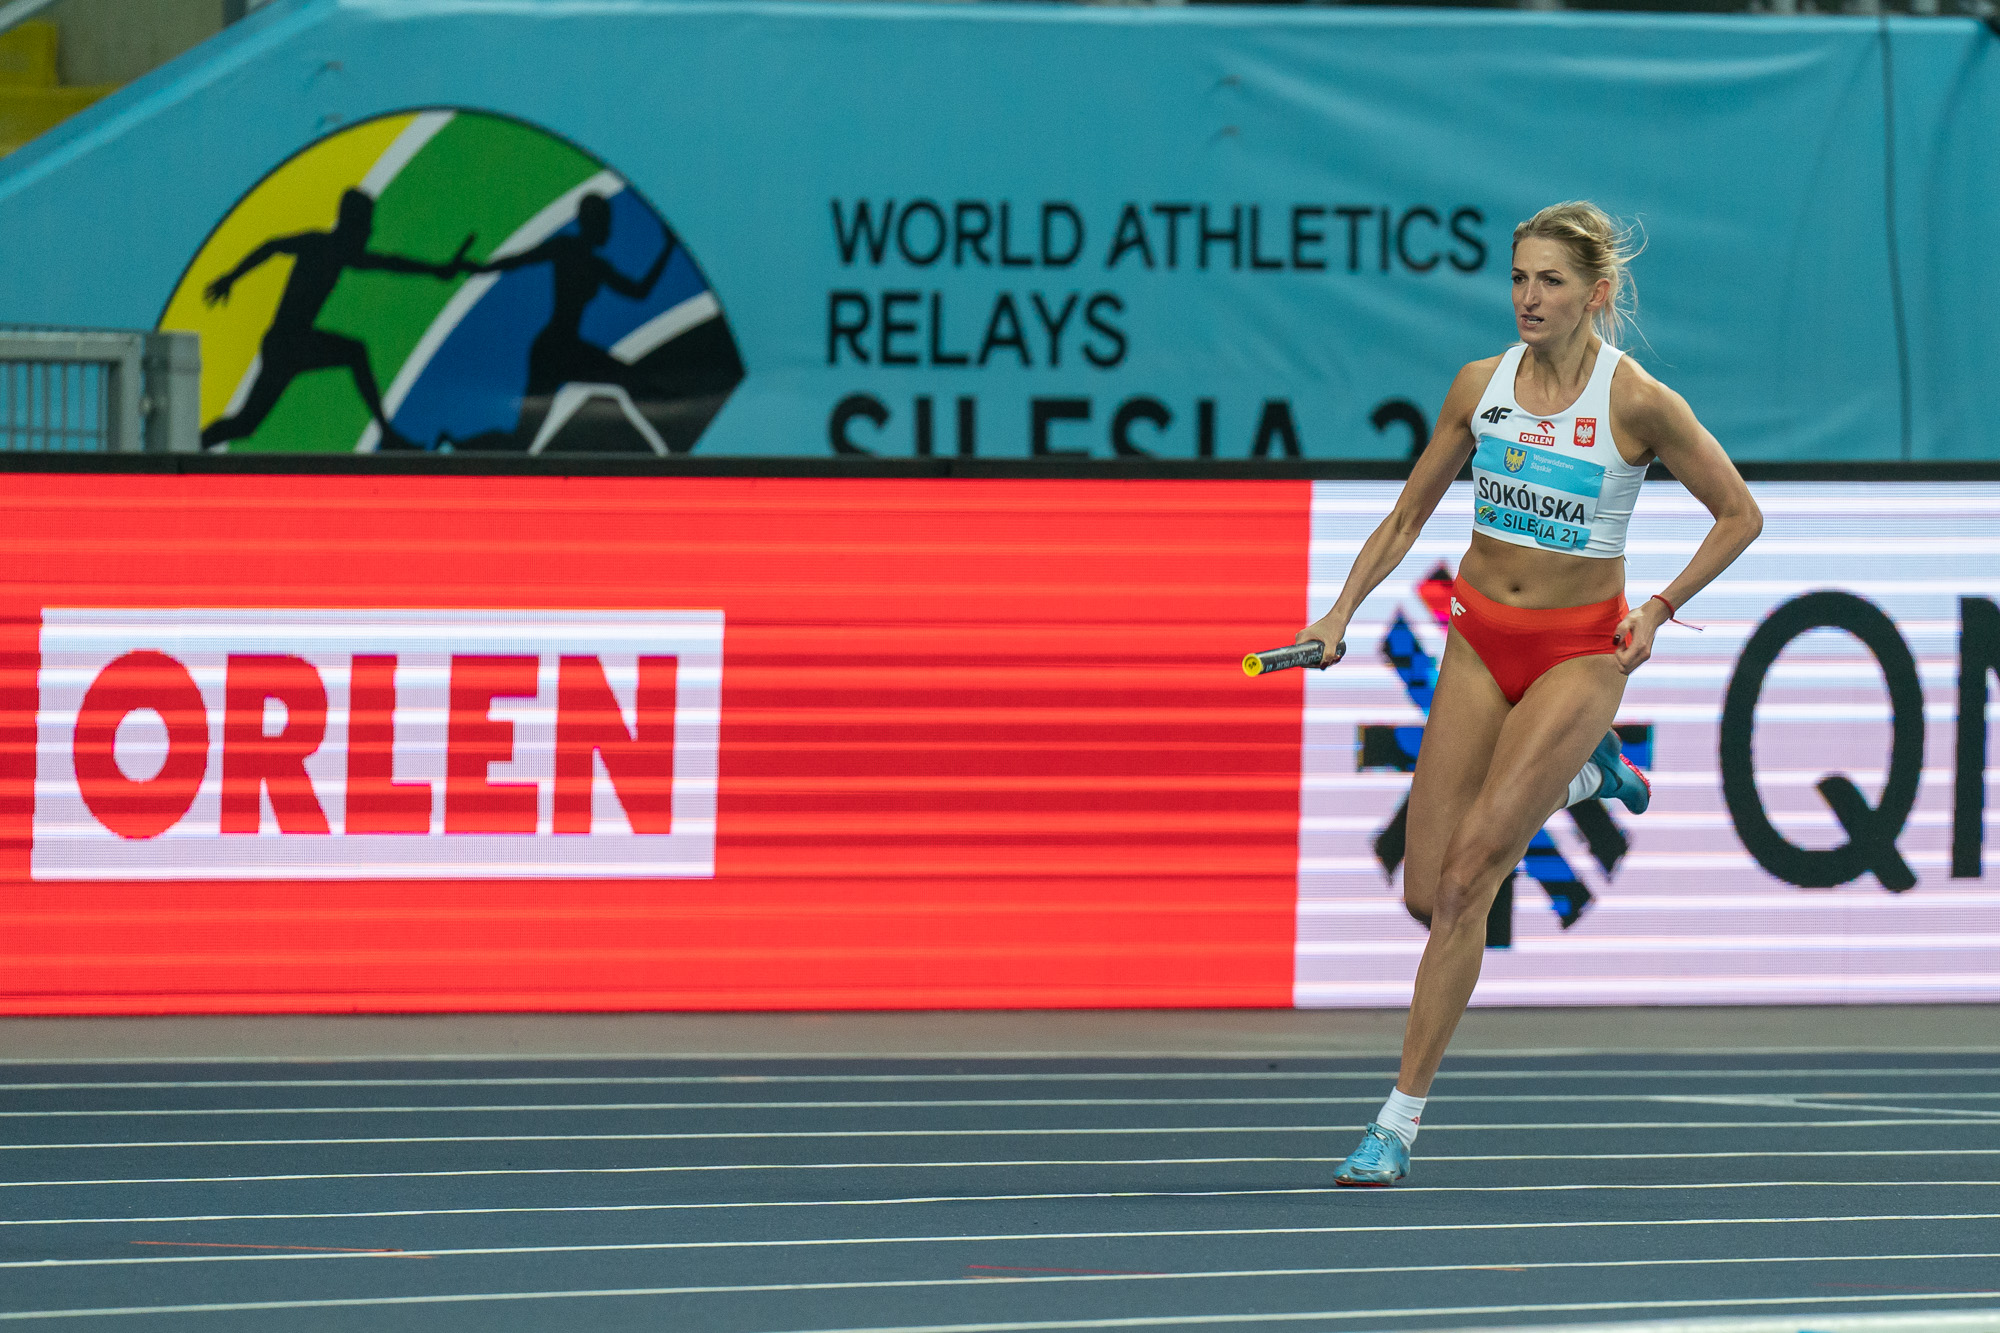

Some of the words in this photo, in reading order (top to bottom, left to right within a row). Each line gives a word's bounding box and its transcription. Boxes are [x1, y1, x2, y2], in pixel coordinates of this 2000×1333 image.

[827, 197, 1088, 271] WORLD
[1103, 201, 1491, 276] ATHLETICS
[825, 290, 1129, 372] RELAYS
[1480, 406, 1512, 424] 4F
[1521, 433, 1553, 445] ORLEN
[1479, 476, 1586, 525] SOKÓLSKA
[1503, 513, 1555, 540] SILESIA
[1560, 528, 1578, 545] 21
[73, 649, 678, 840] ORLEN
